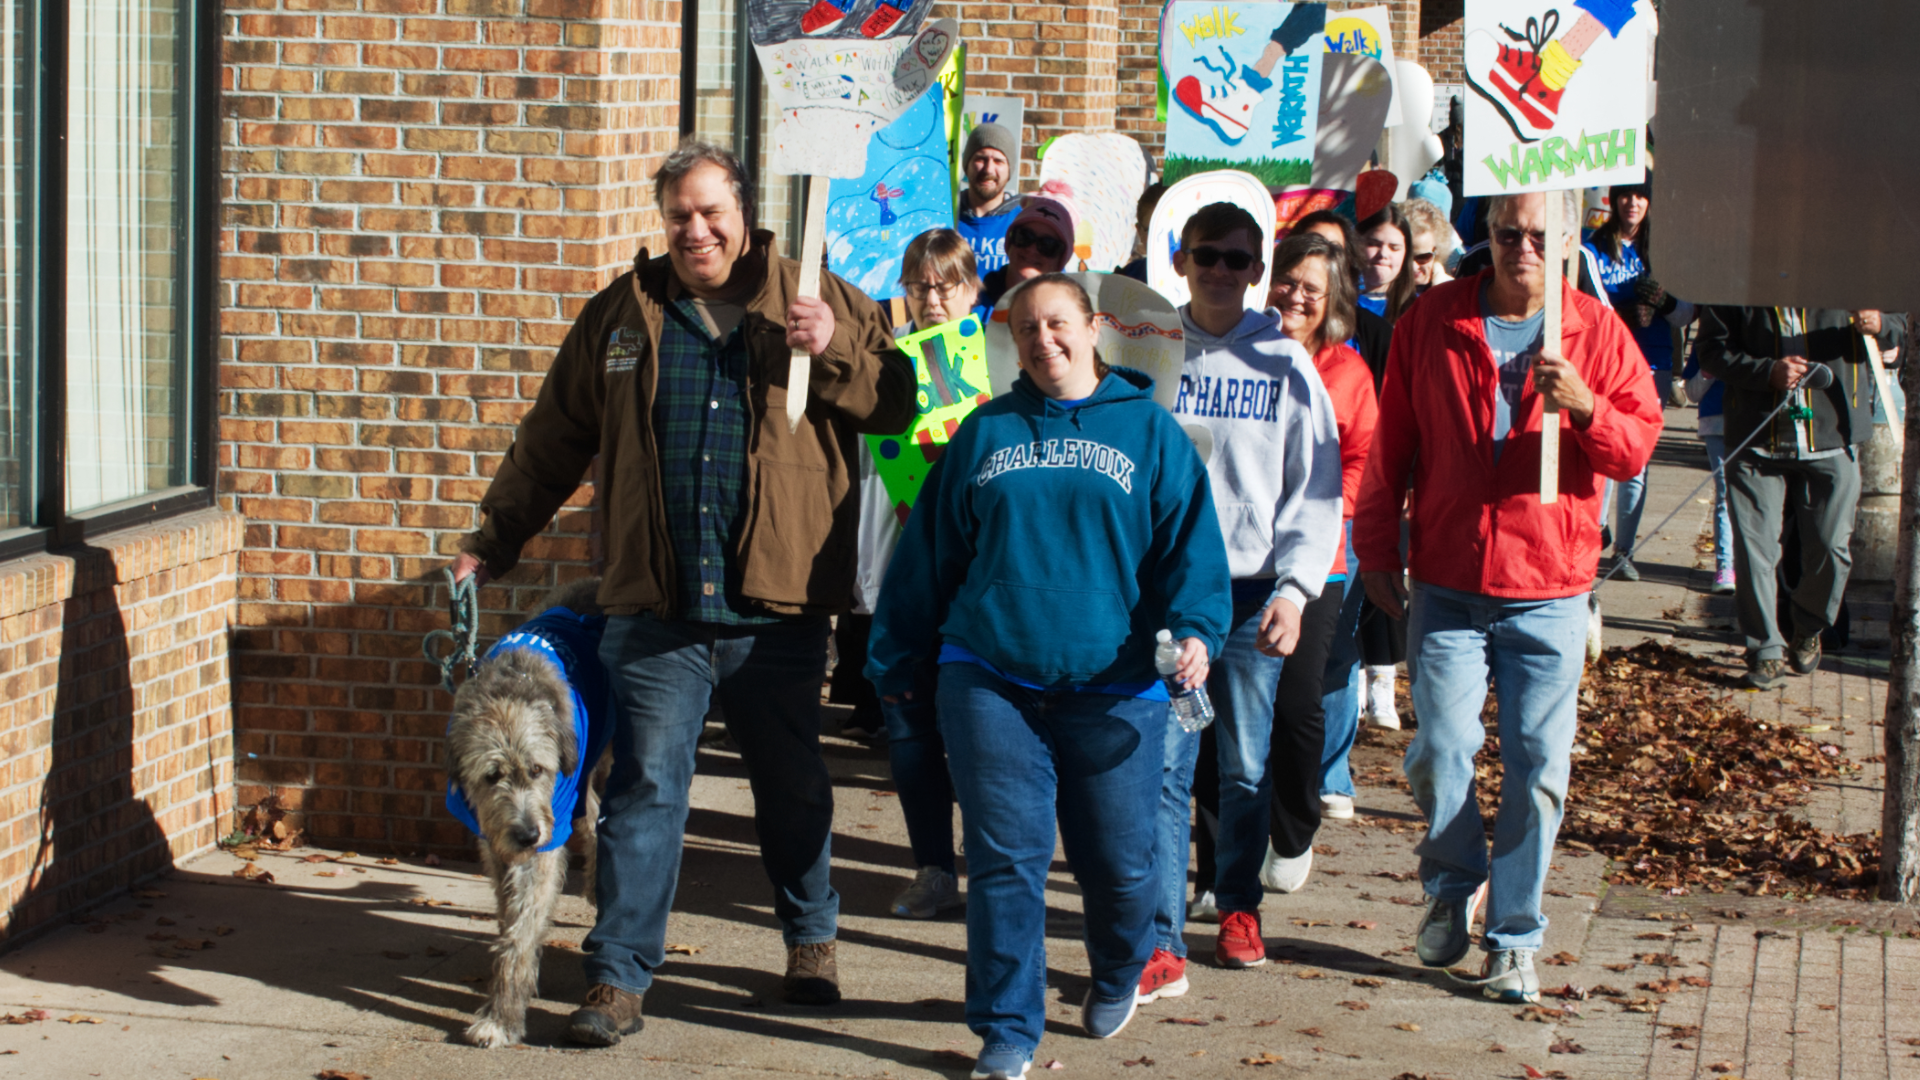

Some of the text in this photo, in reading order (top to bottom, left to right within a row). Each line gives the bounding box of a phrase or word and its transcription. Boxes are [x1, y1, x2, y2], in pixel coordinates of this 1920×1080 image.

[1324, 28, 1369, 54] Walk
[1481, 128, 1637, 190] WARMTH
[1194, 375, 1280, 423] HARBOR
[977, 438, 1135, 494] CHARLEVOIX
